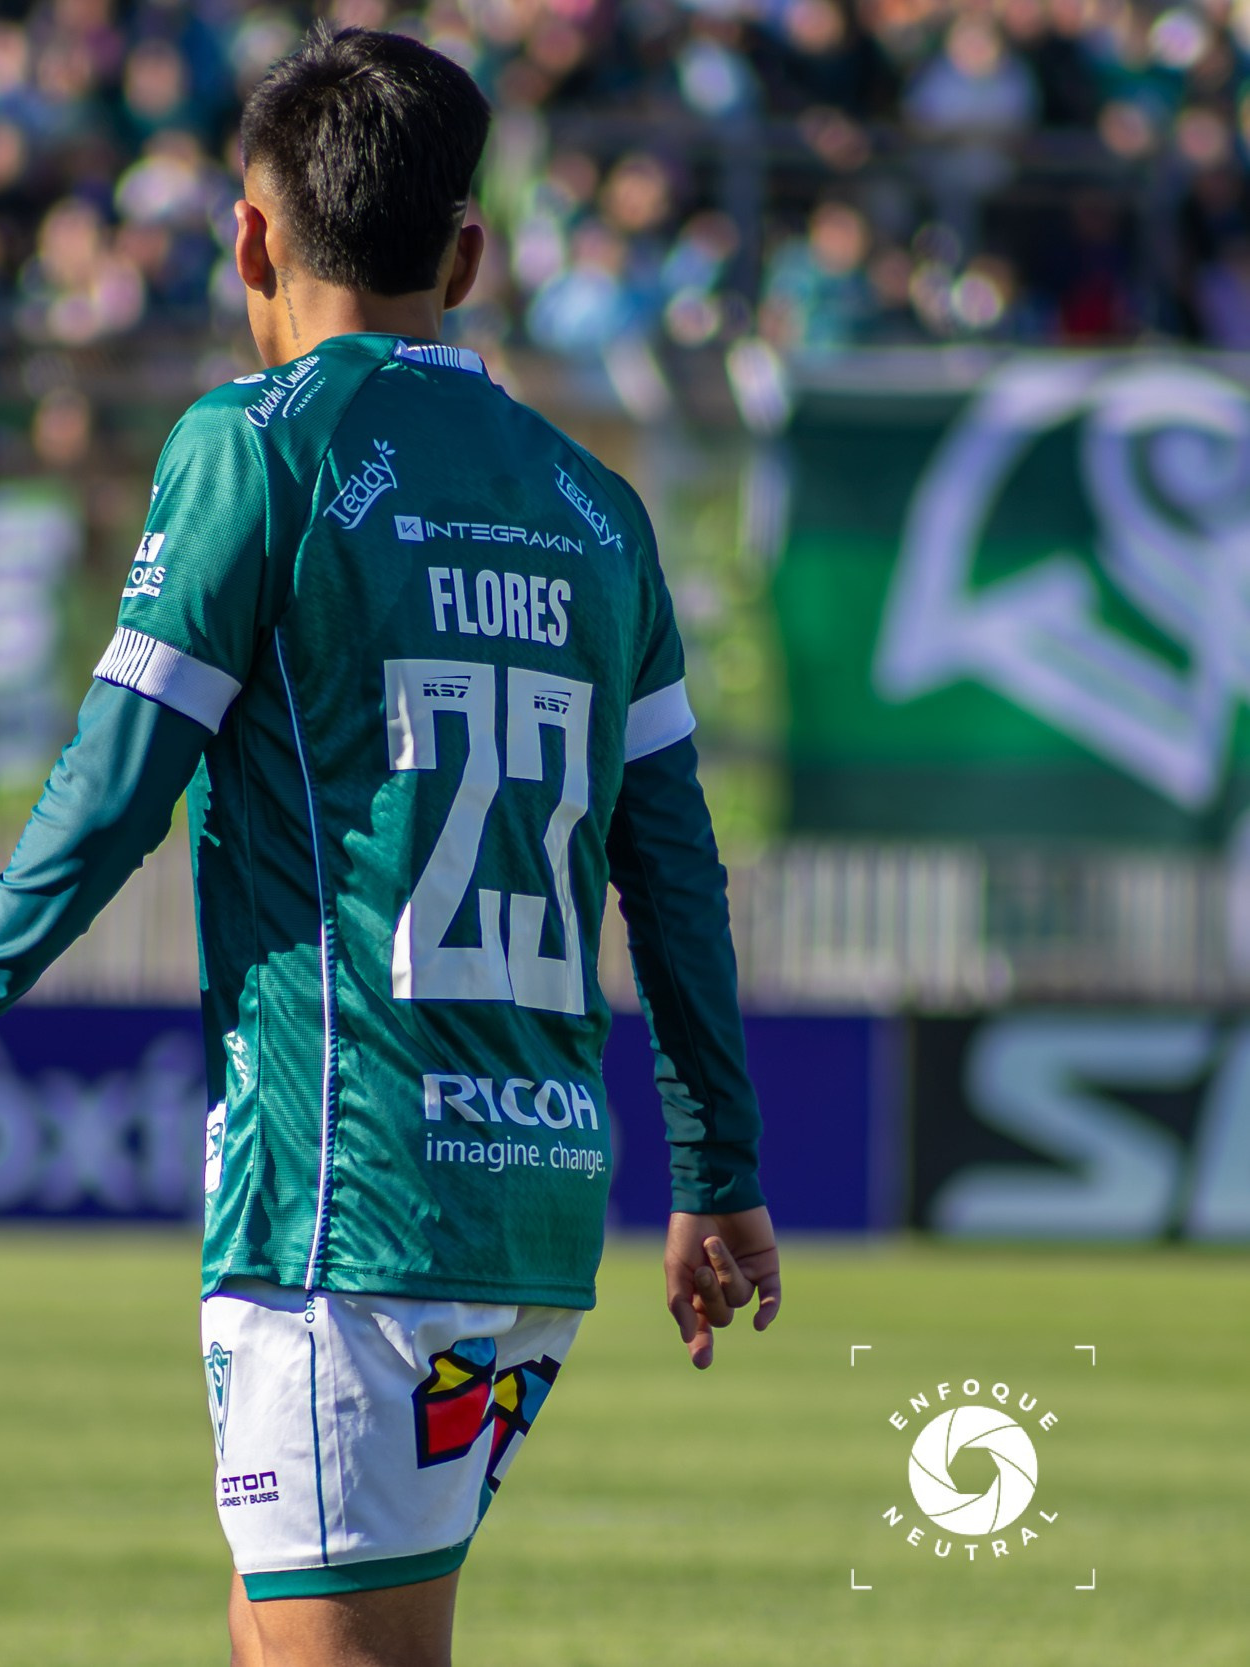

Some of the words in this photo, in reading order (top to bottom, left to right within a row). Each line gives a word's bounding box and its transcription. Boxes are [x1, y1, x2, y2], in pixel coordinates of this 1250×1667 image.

[323, 453, 397, 530] Teddy
[554, 463, 616, 545] Teddy
[425, 521, 583, 554] INTEGRAKIN
[428, 567, 572, 647] FLORES
[423, 1073, 599, 1131] RICOH
[425, 1132, 545, 1173] imagine.
[549, 1140, 606, 1180] change.
[249, 1491, 279, 1504] BUSES
